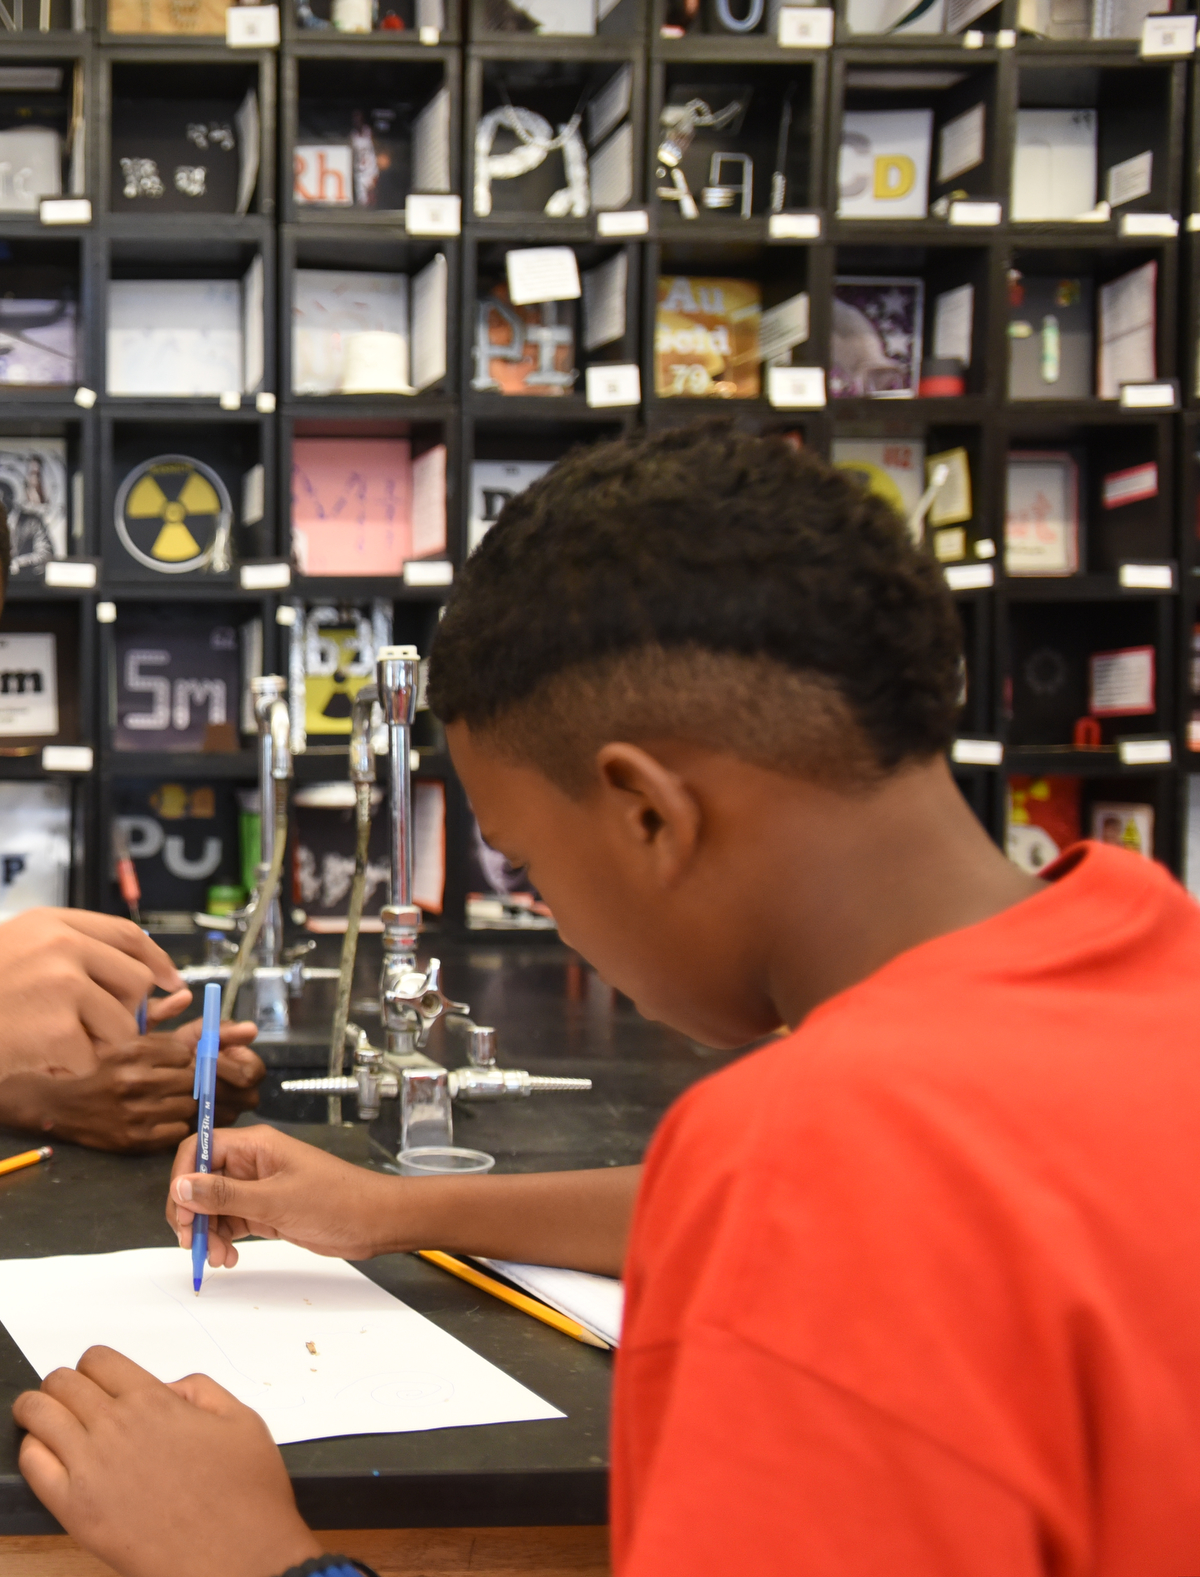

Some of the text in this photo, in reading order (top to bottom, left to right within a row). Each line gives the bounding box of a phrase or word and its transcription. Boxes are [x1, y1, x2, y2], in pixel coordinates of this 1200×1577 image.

[662, 276, 725, 315] Au
[669, 363, 712, 395] 79
[205, 1101, 211, 1110] M
